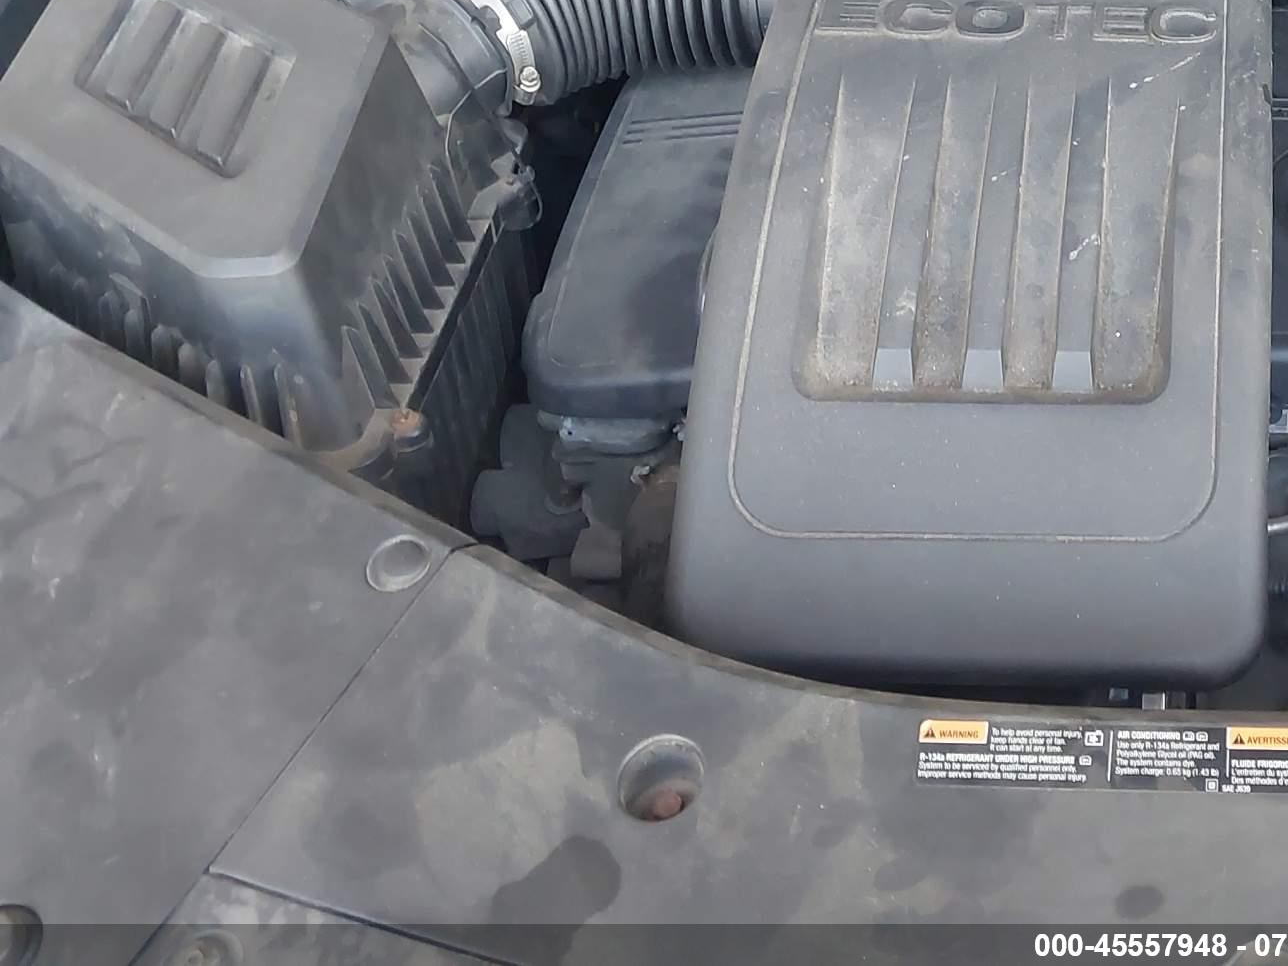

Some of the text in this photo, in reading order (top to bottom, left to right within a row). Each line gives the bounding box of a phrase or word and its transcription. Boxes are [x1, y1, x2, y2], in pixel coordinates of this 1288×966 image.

[814, 0, 1217, 42] ECOTEC
[939, 730, 979, 738] WARNING
[1000, 728, 1014, 738] help
[1015, 729, 1033, 737] avoid
[1034, 729, 1062, 738] personal
[1063, 730, 1082, 739] injury,
[1118, 730, 1180, 740] AIR CONDITIONING
[991, 736, 1007, 745] keep
[1033, 746, 1045, 754] any
[1117, 740, 1219, 752] Use only R-134a Refrigerant and
[919, 753, 1075, 764] R-134a REFRIGERANT UNDER HIGH PRESSURE
[1116, 758, 1196, 769] The system contains dye.
[1231, 759, 1256, 768] FLUIDE
[919, 761, 943, 771] System
[990, 764, 999, 772] by
[1000, 764, 1028, 773] qualified
[1029, 765, 1060, 773] personnel
[1061, 765, 1076, 774] only.
[1115, 766, 1140, 776] System
[917, 770, 947, 779] Improper
[973, 771, 1001, 779] methods
[1002, 772, 1016, 781] may
[1038, 773, 1066, 782] personal
[1067, 774, 1086, 783] injury.
[1221, 784, 1234, 792] SAE
